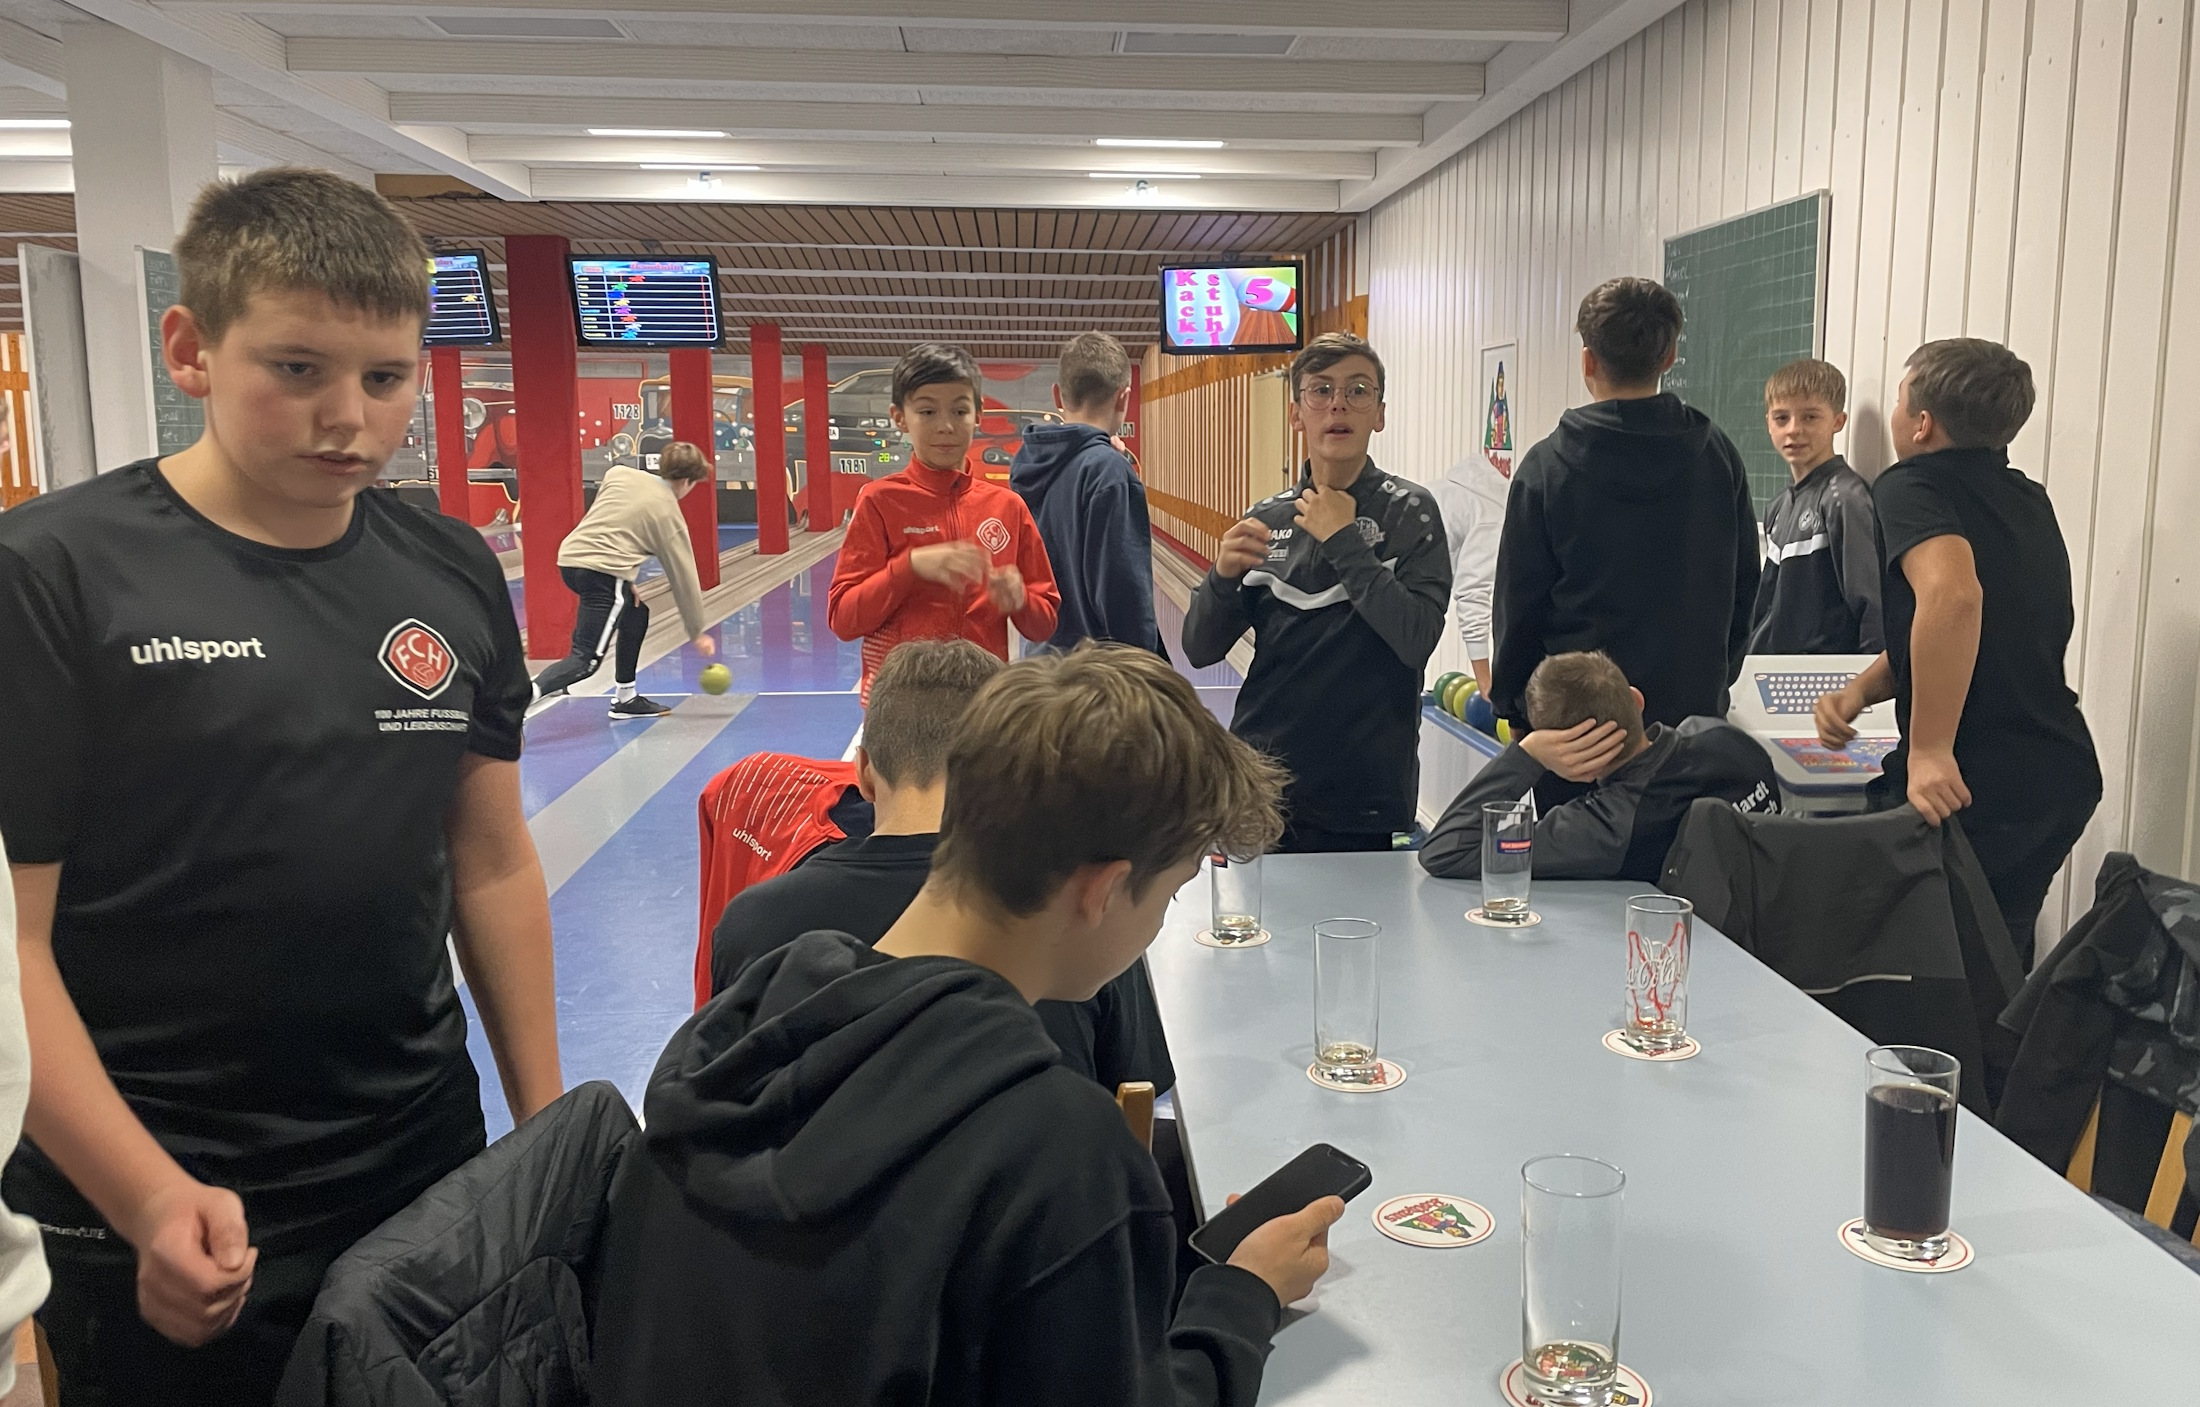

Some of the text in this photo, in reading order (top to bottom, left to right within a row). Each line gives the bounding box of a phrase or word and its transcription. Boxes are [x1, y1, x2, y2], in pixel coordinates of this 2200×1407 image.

[1245, 278, 1274, 305] 5
[613, 403, 640, 420] 1928
[840, 458, 867, 474] 1981
[1268, 529, 1293, 540] AKO
[130, 636, 266, 664] uhlsport
[395, 633, 443, 670] FCH
[393, 709, 430, 719] JAHRE
[378, 722, 402, 731] UND
[732, 827, 772, 861] uhlsport
